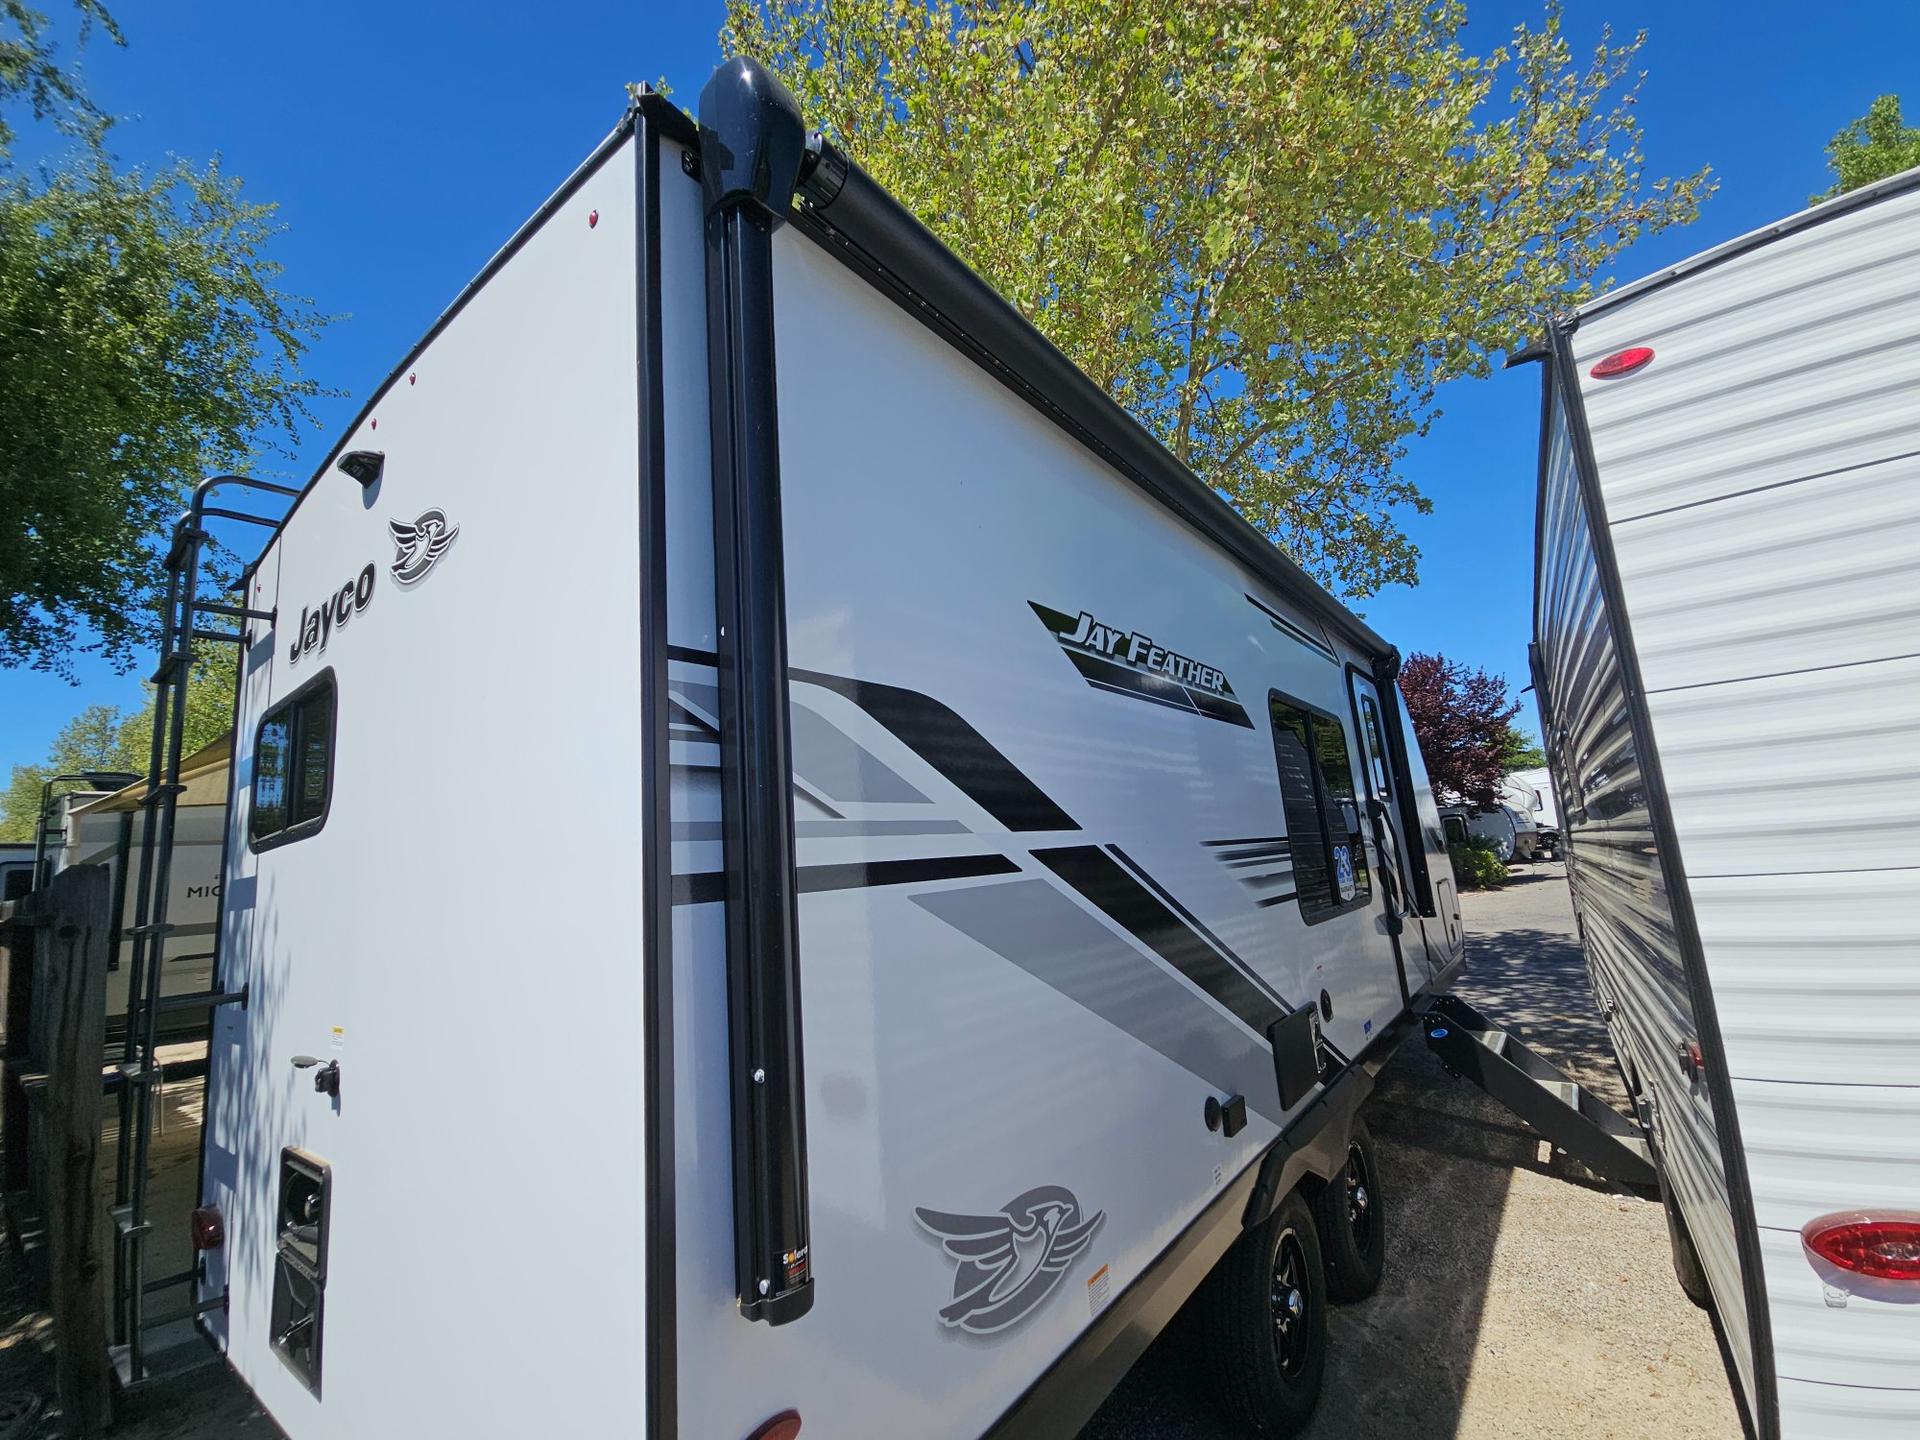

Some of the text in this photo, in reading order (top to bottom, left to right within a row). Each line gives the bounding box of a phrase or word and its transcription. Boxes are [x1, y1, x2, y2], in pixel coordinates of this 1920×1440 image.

[289, 561, 375, 663] Jayco
[1058, 612, 1225, 692] JAY FEATHER
